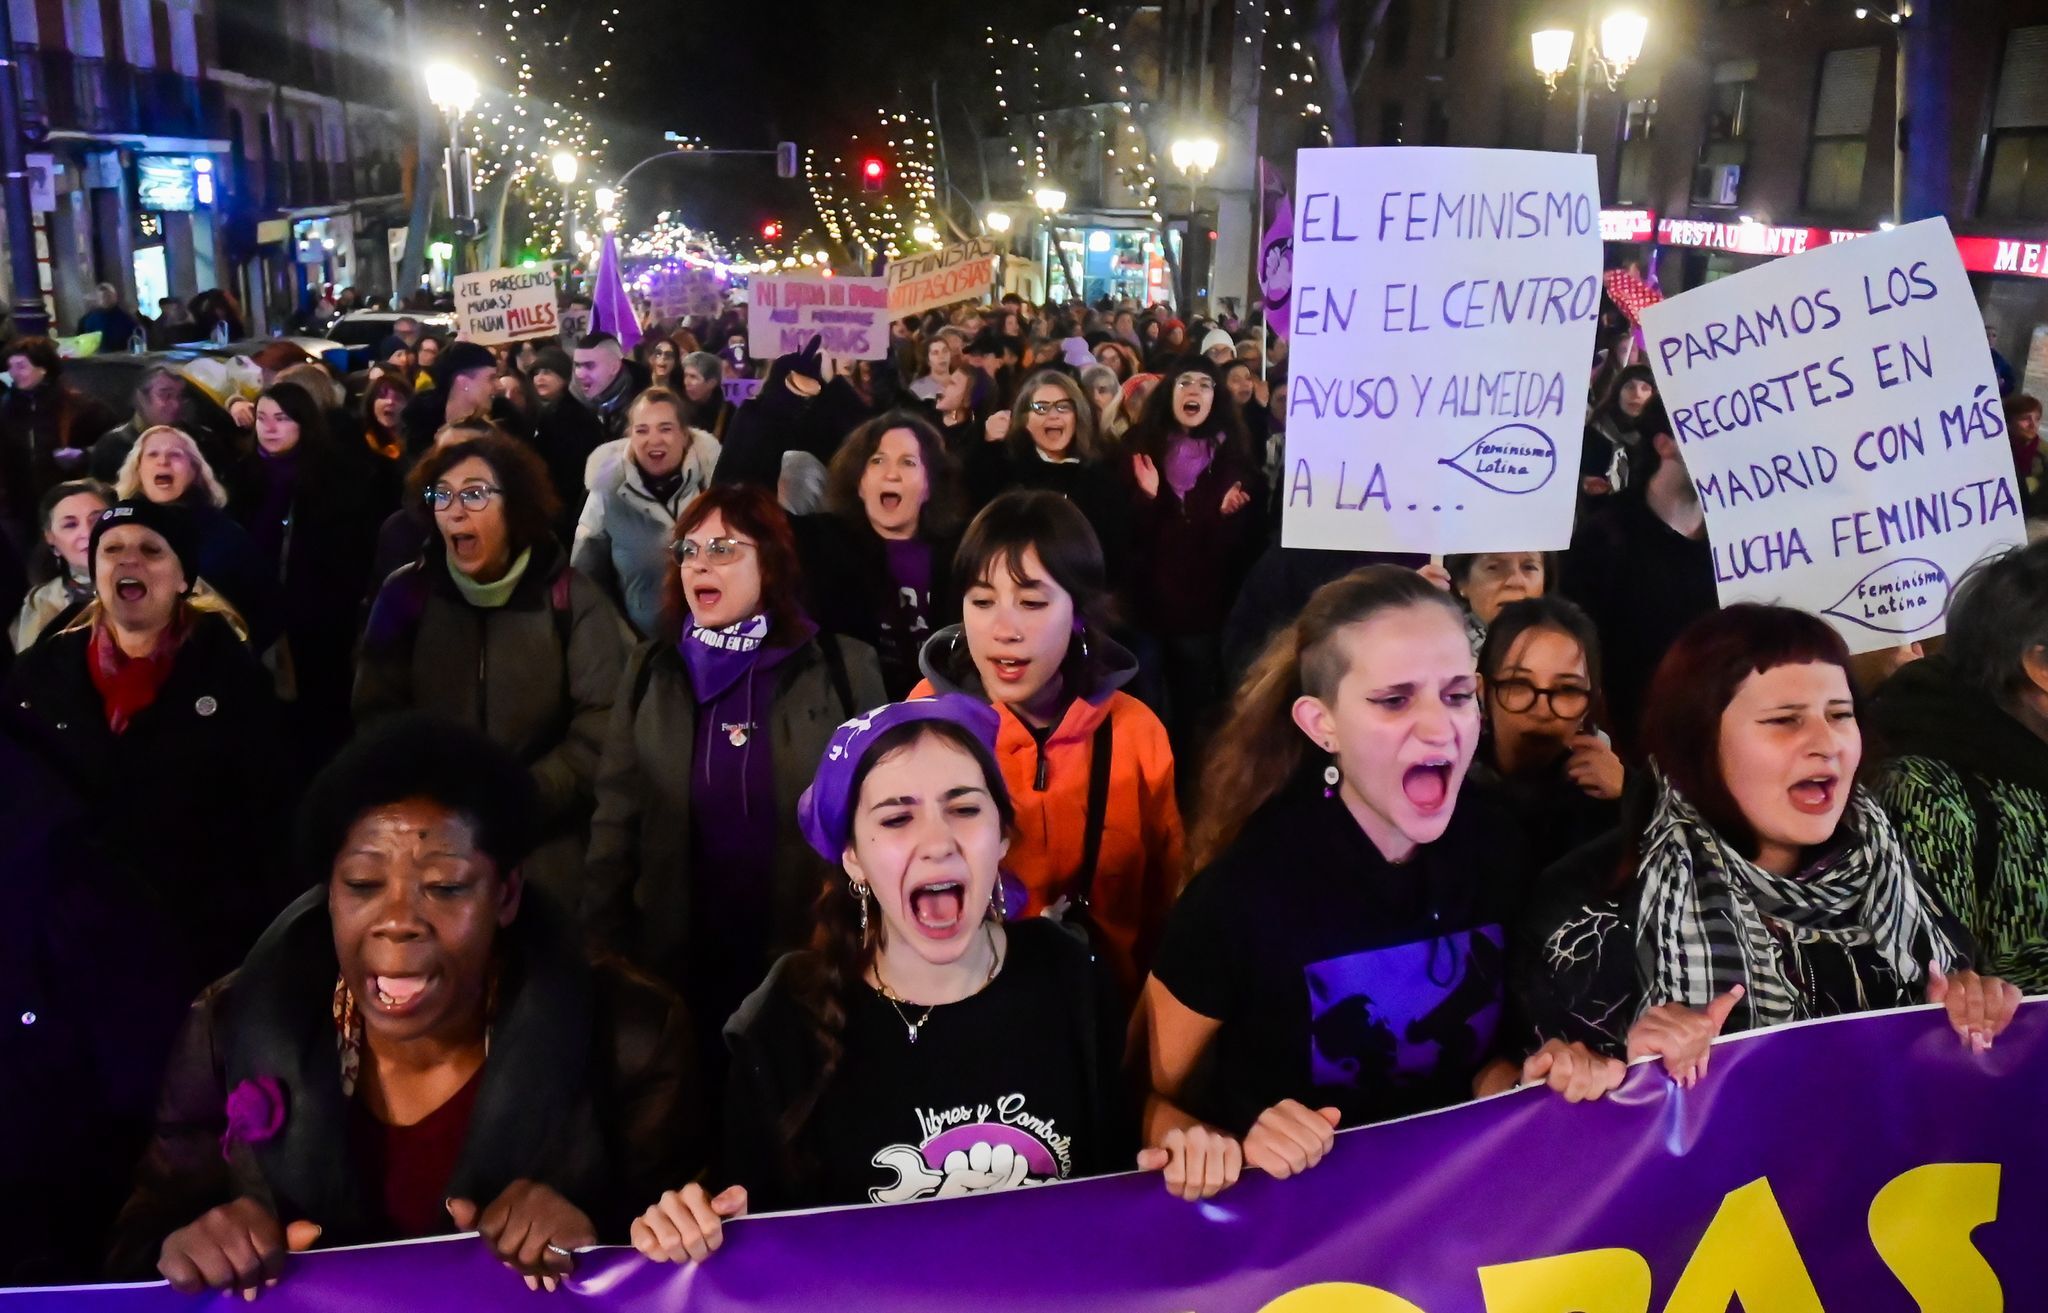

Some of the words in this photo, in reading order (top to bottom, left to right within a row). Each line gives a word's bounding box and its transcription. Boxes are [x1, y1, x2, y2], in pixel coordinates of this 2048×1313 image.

[1302, 192, 1358, 243] EL
[1378, 191, 1592, 242] FEMINISMO
[1993, 240, 2048, 274] ME
[460, 281, 482, 298] ¿TE
[490, 271, 553, 293] PARECEMOS
[1294, 286, 1357, 336] EN
[1383, 283, 1430, 332] EL
[1442, 275, 1599, 330] CENTRO.
[507, 303, 556, 330] MILES
[1659, 288, 1842, 377] PARAMOS
[1864, 261, 1938, 316] LOS
[1290, 375, 1399, 419] AYUSO
[1411, 374, 1432, 417] Y
[1440, 371, 1565, 418] ALMEIDA
[1673, 355, 1854, 444] RECORTES
[1873, 335, 1933, 389] EN
[1697, 445, 1838, 514] MADRID
[1853, 416, 1924, 472] CON
[1940, 384, 2004, 450] MÁS
[1290, 458, 1313, 508] A
[1712, 527, 1812, 583] LUCHA
[1832, 477, 2018, 558] FEMINISTA
[1864, 595, 1927, 619] Latina
[915, 1105, 973, 1150] Libres
[977, 1103, 992, 1125] y
